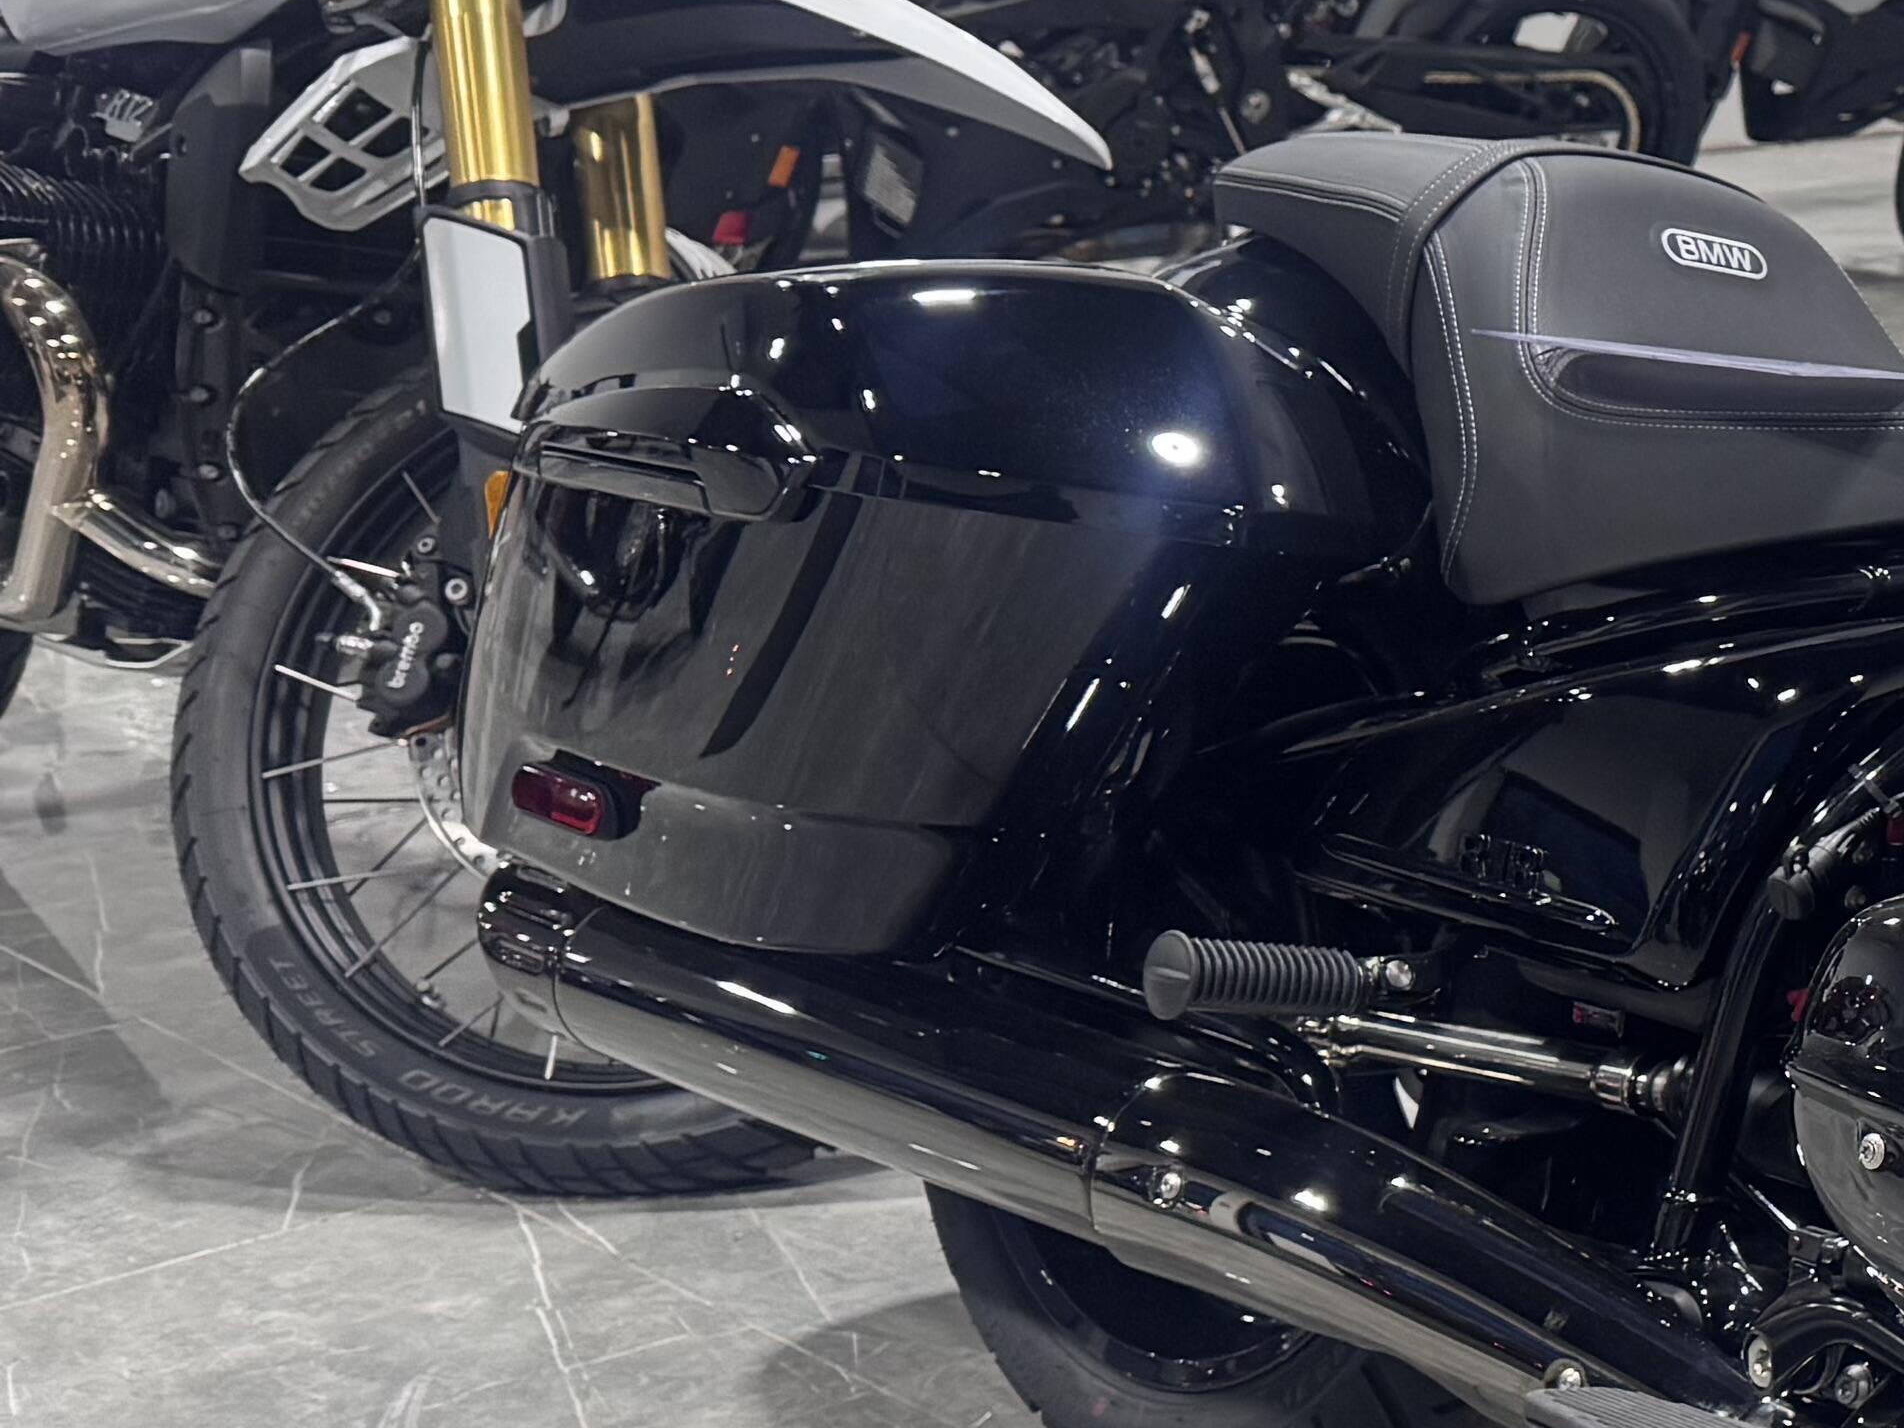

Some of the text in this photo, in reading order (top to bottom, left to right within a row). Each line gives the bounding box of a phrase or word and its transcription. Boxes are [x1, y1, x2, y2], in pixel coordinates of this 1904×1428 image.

[1676, 235, 1751, 271] BMW
[386, 622, 424, 688] brembo
[270, 958, 384, 1059] STREET
[402, 1070, 588, 1127] KAROO
